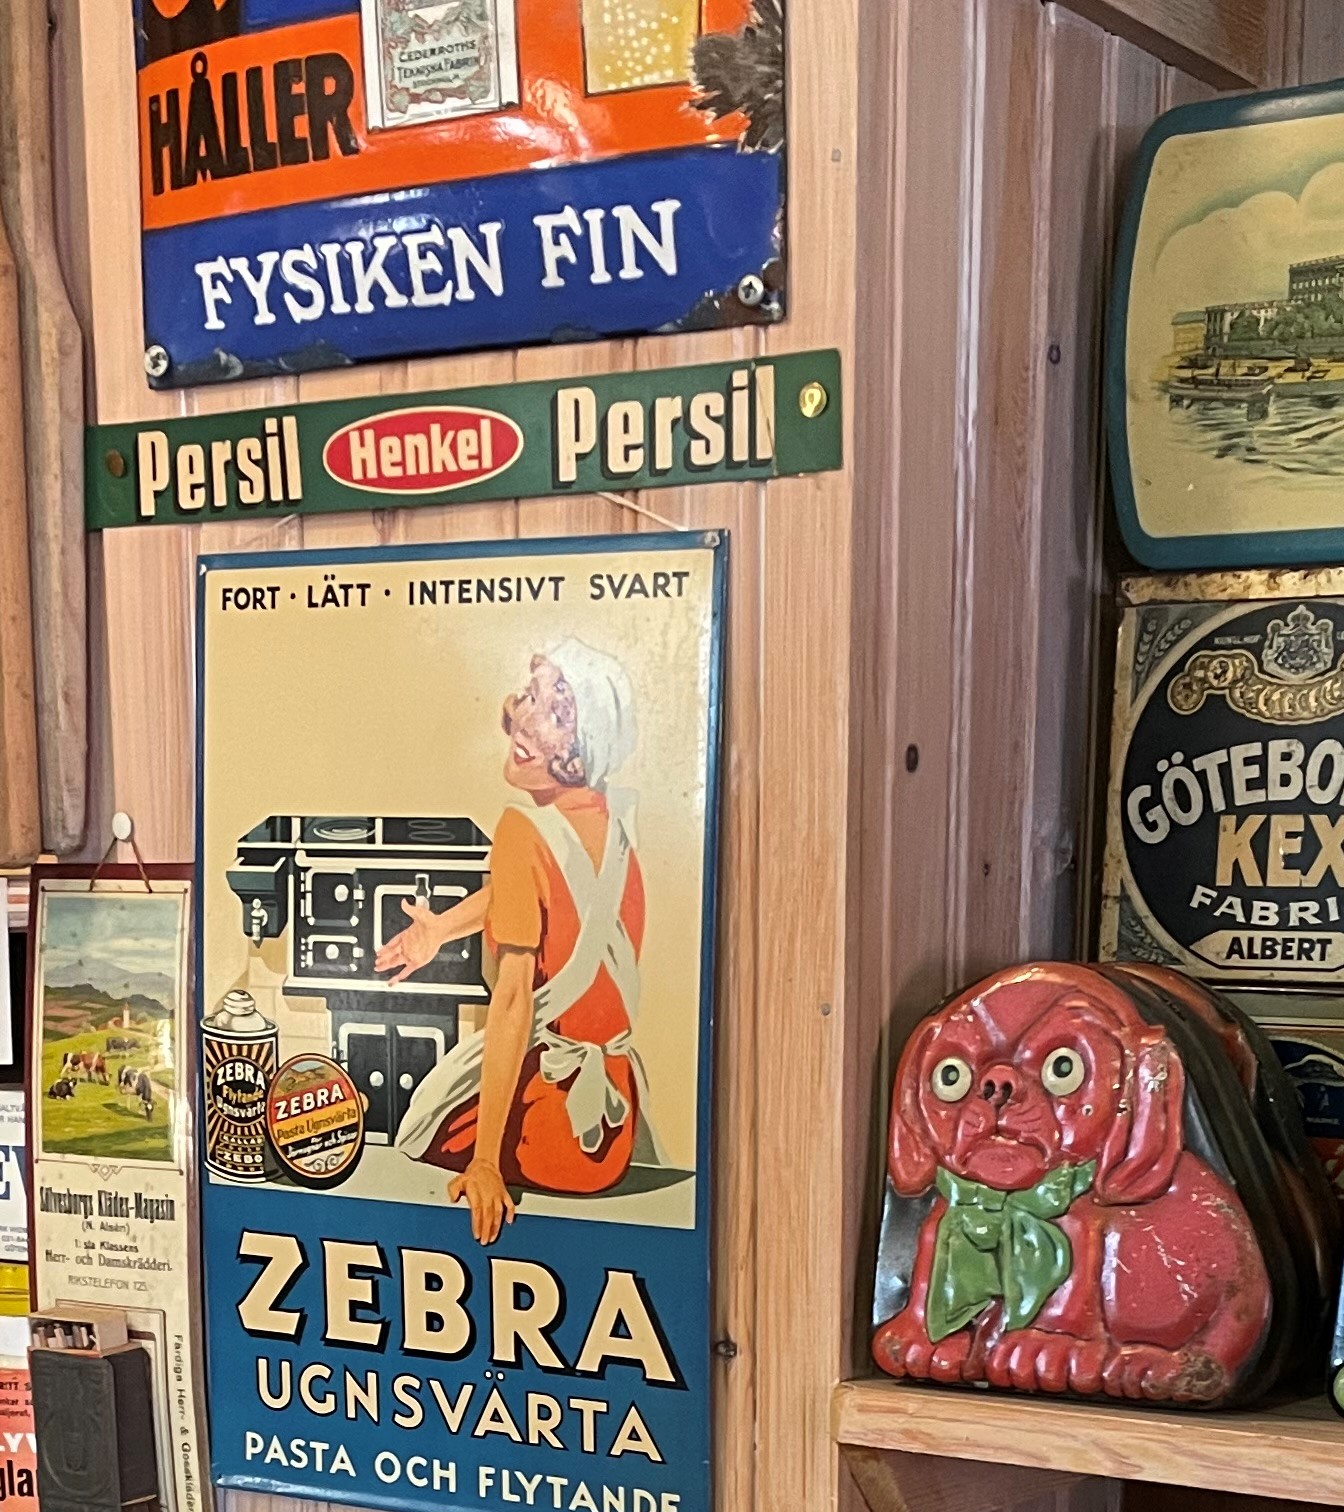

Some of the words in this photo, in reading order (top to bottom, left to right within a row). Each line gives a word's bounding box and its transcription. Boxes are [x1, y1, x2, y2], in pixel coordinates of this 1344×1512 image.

[149, 51, 361, 197] HÅLLER
[194, 220, 504, 331] FYSIKEN
[532, 199, 682, 288] FIN
[137, 415, 304, 517] Persil
[349, 422, 494, 484] Henkel
[557, 364, 778, 483] Persil
[221, 585, 281, 611] FORT
[306, 574, 371, 608] LÄTT
[408, 575, 566, 607] INTENSIVT
[588, 571, 690, 600] SVART
[1225, 937, 1333, 962] ALBERT
[216, 1062, 267, 1090] ZEBRA
[274, 1083, 345, 1120] ZEBRA
[276, 1124, 305, 1140] Pasta
[306, 1107, 357, 1134] Ugnsvärta
[75, 1253, 93, 1266] och
[237, 1229, 687, 1390] ZEBRA
[256, 1357, 665, 1464] UGNSVÄRTA
[244, 1431, 357, 1477] PASTA
[374, 1452, 457, 1493] OCH
